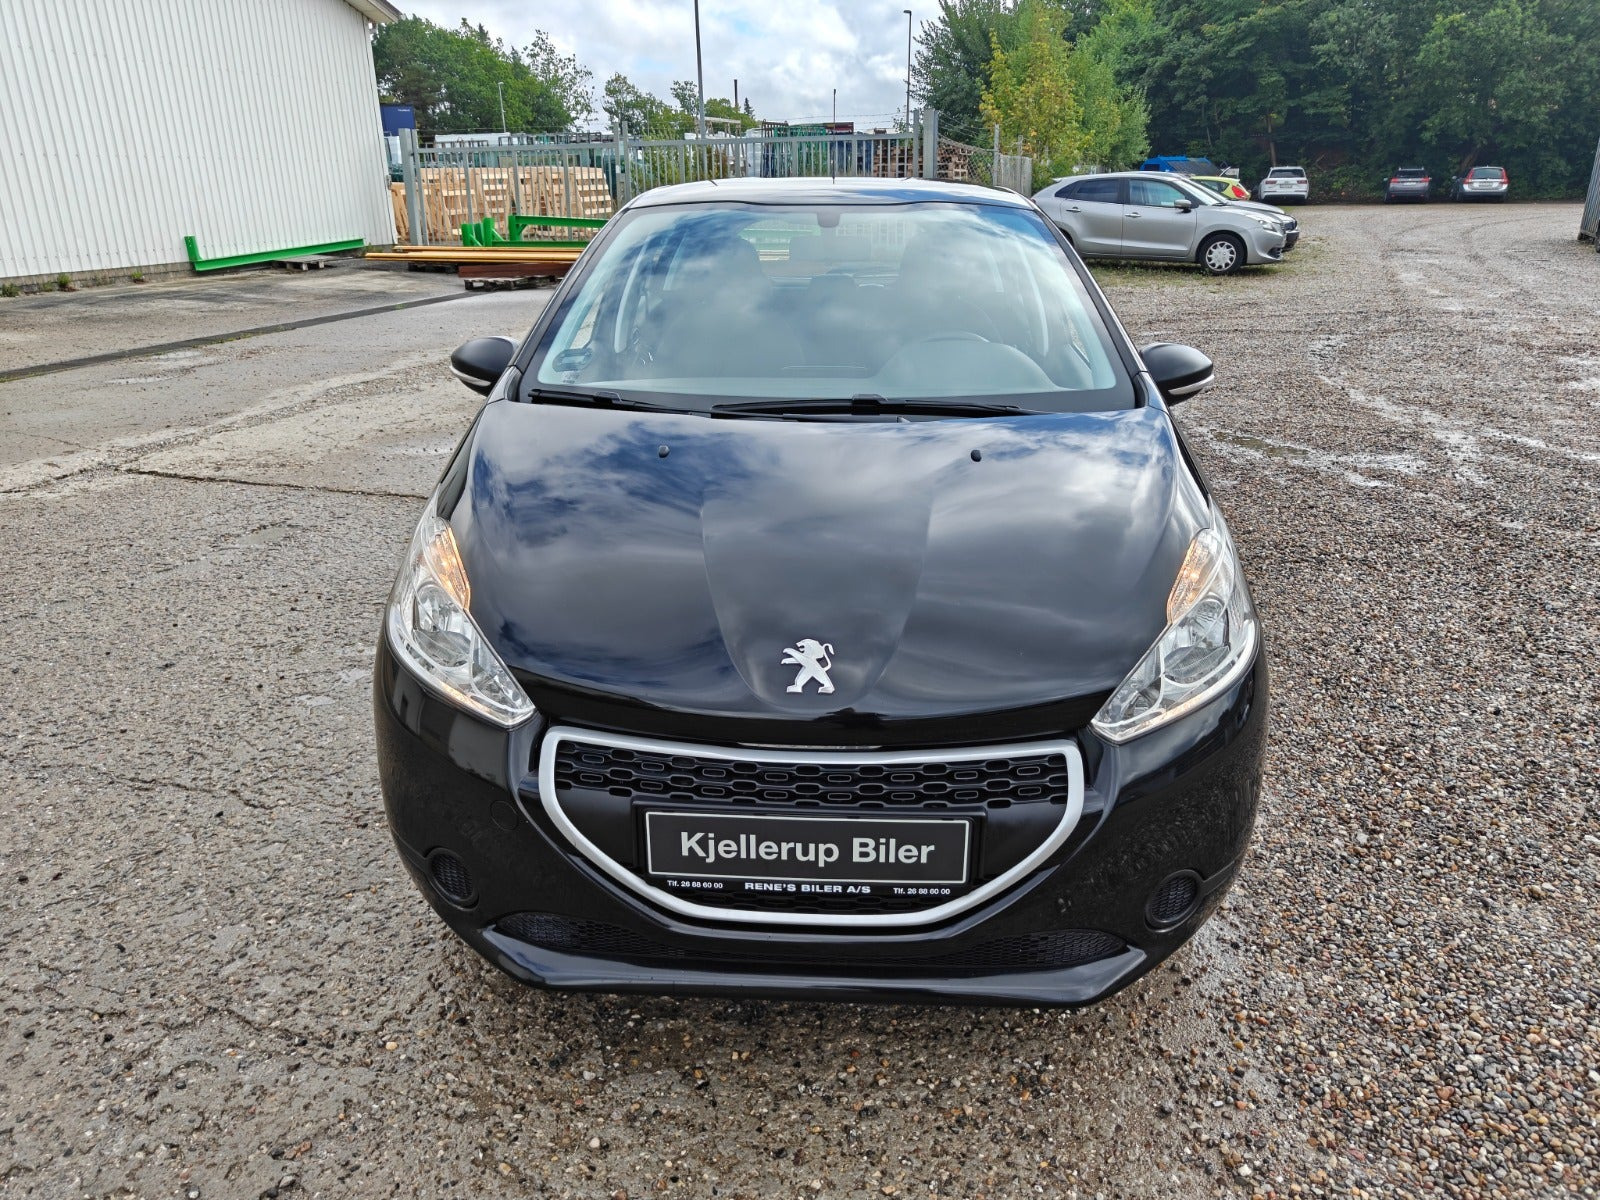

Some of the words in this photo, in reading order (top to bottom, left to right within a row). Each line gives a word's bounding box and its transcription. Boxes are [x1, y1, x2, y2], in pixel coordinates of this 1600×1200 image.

[680, 831, 839, 868] Kjellerup
[853, 837, 935, 865] Biler
[702, 881, 713, 889] 60
[744, 882, 797, 892] RENE'S
[800, 884, 843, 893] BILER
[846, 885, 871, 894] A/S
